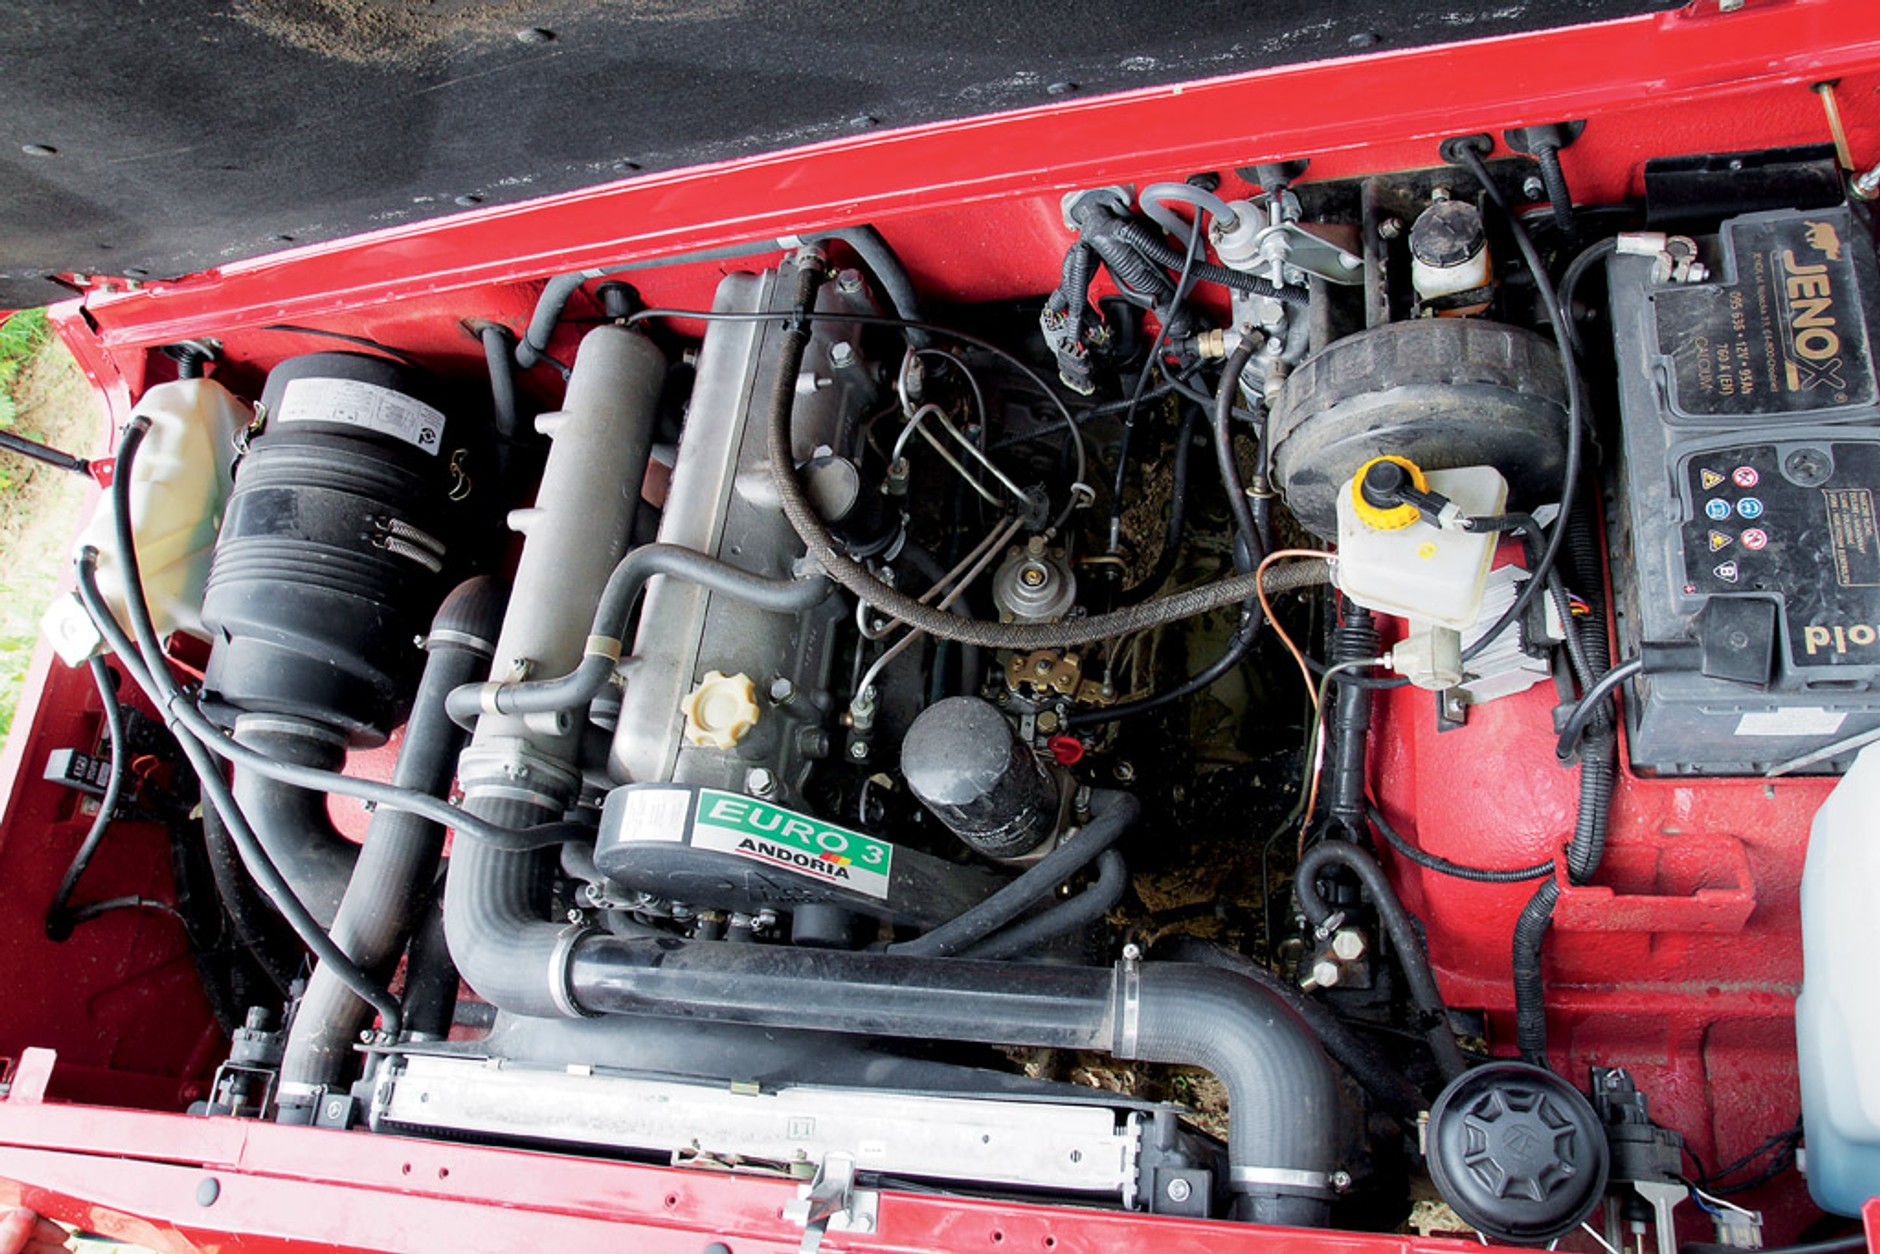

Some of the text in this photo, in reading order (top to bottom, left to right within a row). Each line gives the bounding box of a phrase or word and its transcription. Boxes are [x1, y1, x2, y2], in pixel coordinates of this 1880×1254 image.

[1783, 249, 1847, 391] JENOX
[1735, 341, 1749, 360] 12V
[1804, 624, 1880, 655] old
[708, 798, 849, 852] EURO
[861, 844, 885, 865] 3
[738, 837, 851, 880] ANDORIA
